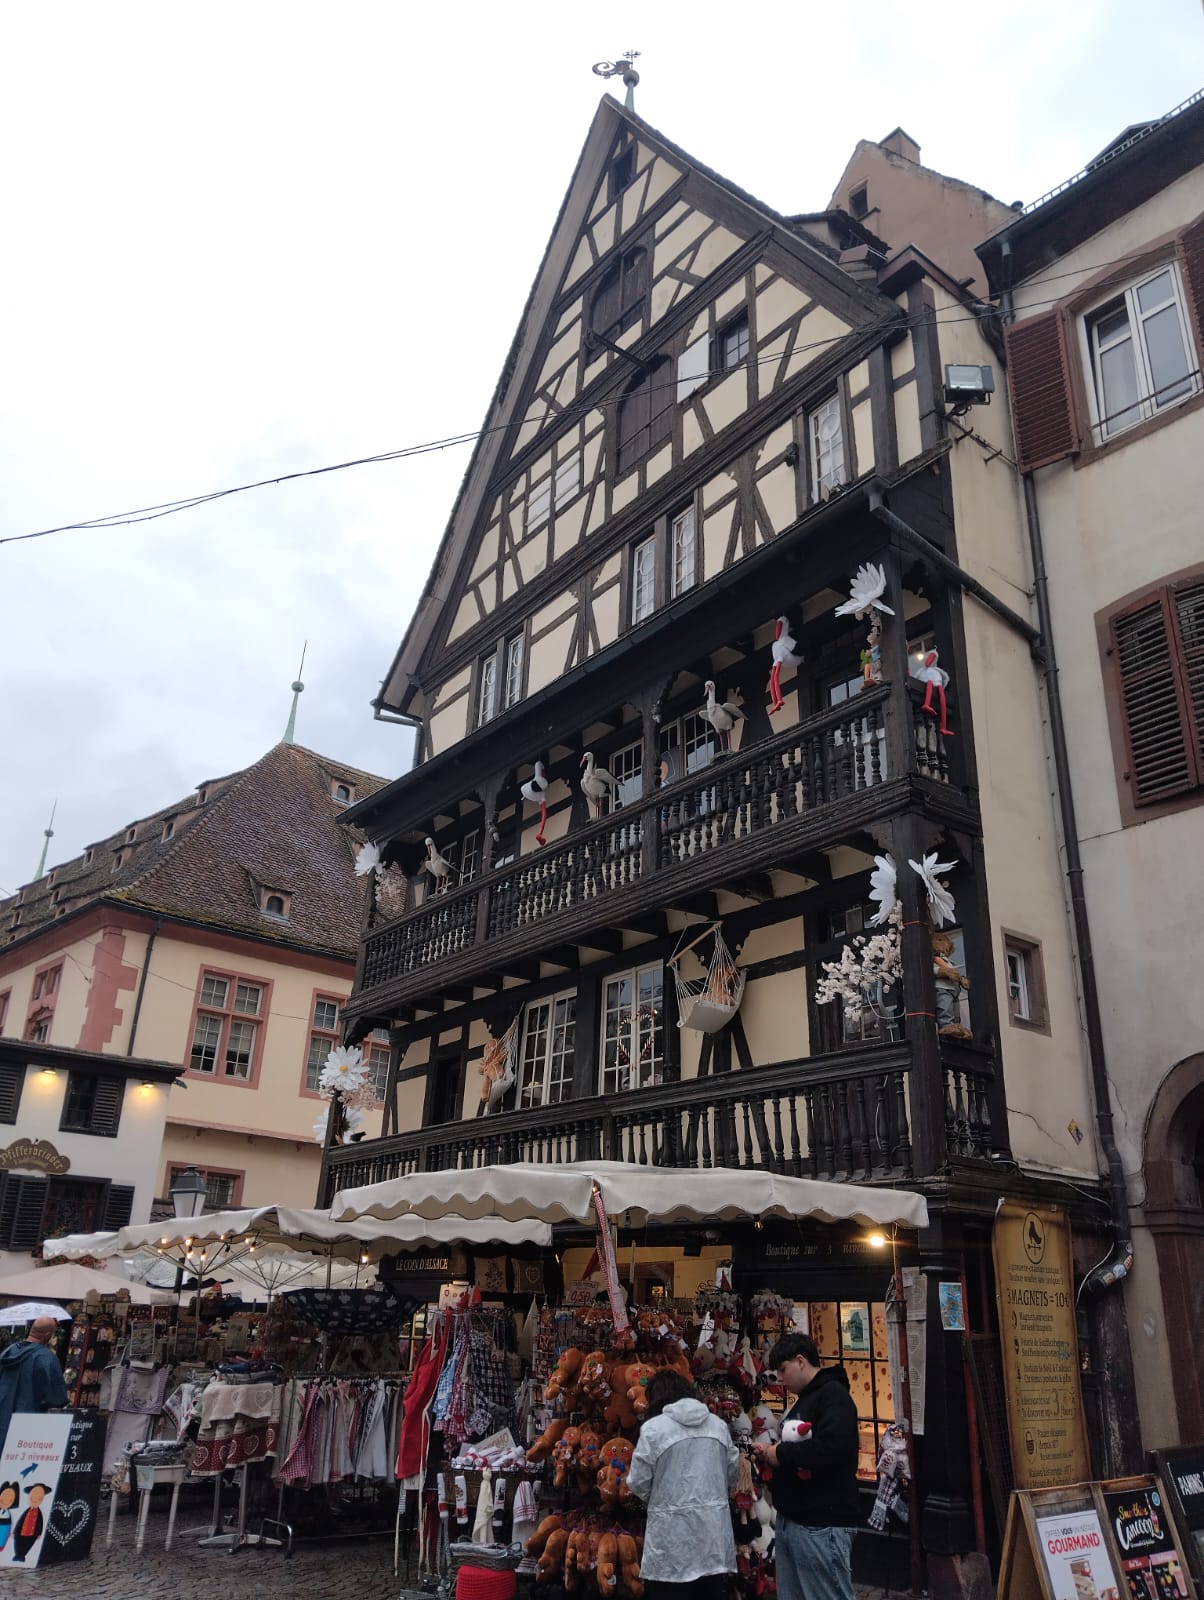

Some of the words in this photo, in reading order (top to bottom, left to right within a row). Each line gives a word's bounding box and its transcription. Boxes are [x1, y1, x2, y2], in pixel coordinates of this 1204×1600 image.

[766, 1243, 800, 1260] Boutique
[403, 1258, 419, 1271] COIN
[419, 1257, 449, 1270] D'ALSACE
[1011, 1288, 1049, 1307] MAGNETS
[17, 1440, 54, 1450] Boutique
[5, 1453, 19, 1461] sur
[20, 1452, 26, 1461] 3
[28, 1452, 60, 1462] niveaux
[70, 1445, 78, 1460] 3
[62, 1462, 94, 1473] VEAUX
[1061, 1527, 1073, 1536] VOUS
[1047, 1532, 1101, 1555] GOURMAND
